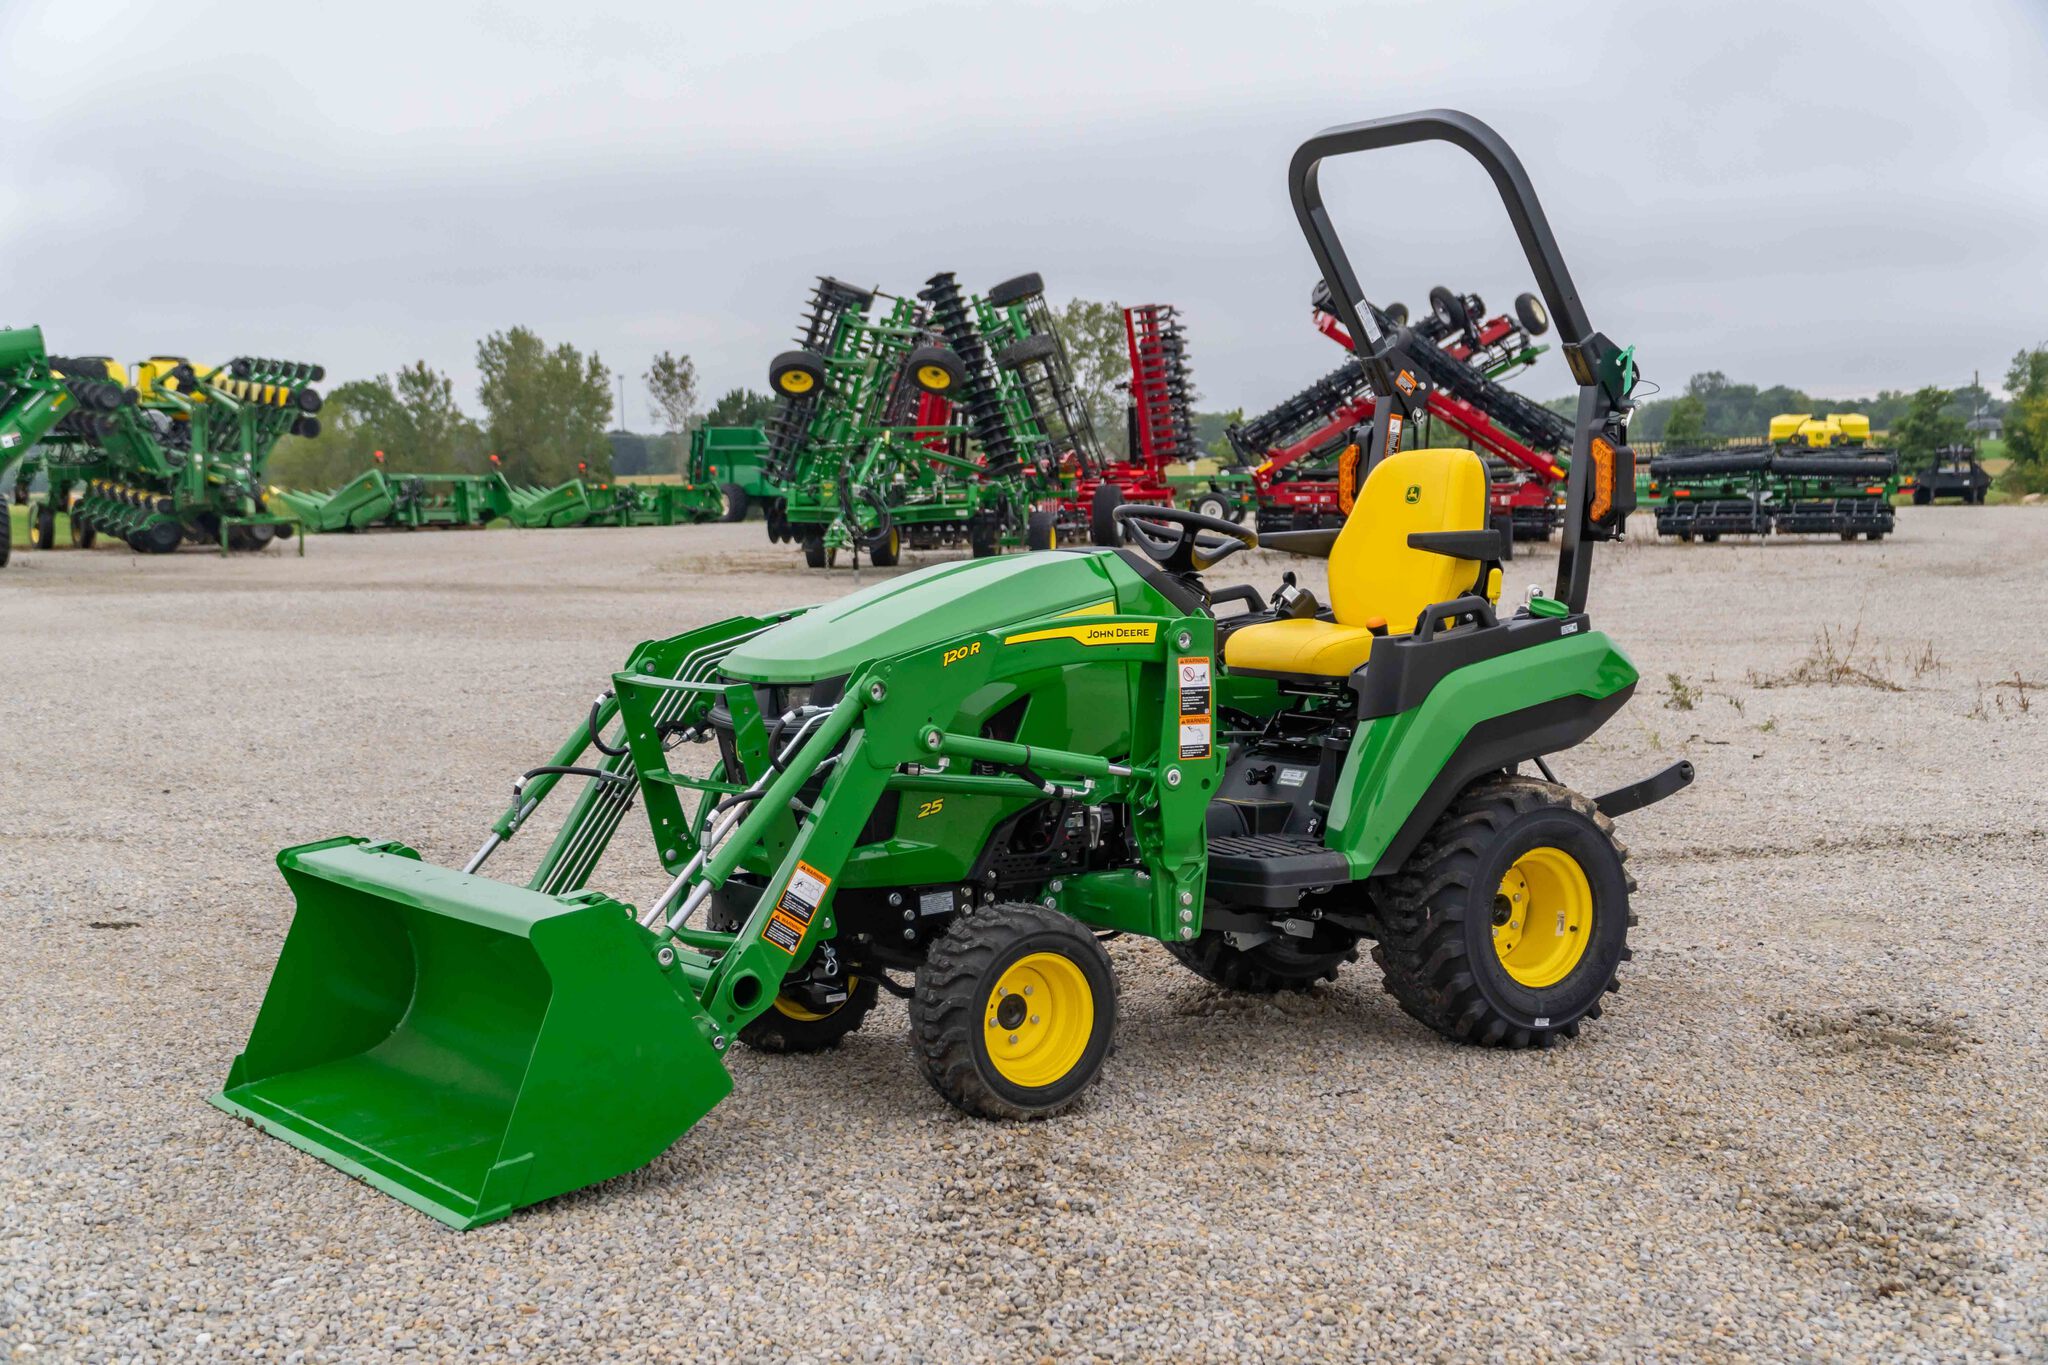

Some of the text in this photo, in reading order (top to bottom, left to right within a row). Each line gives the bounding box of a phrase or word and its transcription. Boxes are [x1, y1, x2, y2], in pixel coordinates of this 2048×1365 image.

[1087, 628, 1149, 639] JOHN DEERE
[917, 798, 944, 819] 25
[806, 867, 827, 883] WARNING
[781, 917, 801, 931] WARNING
